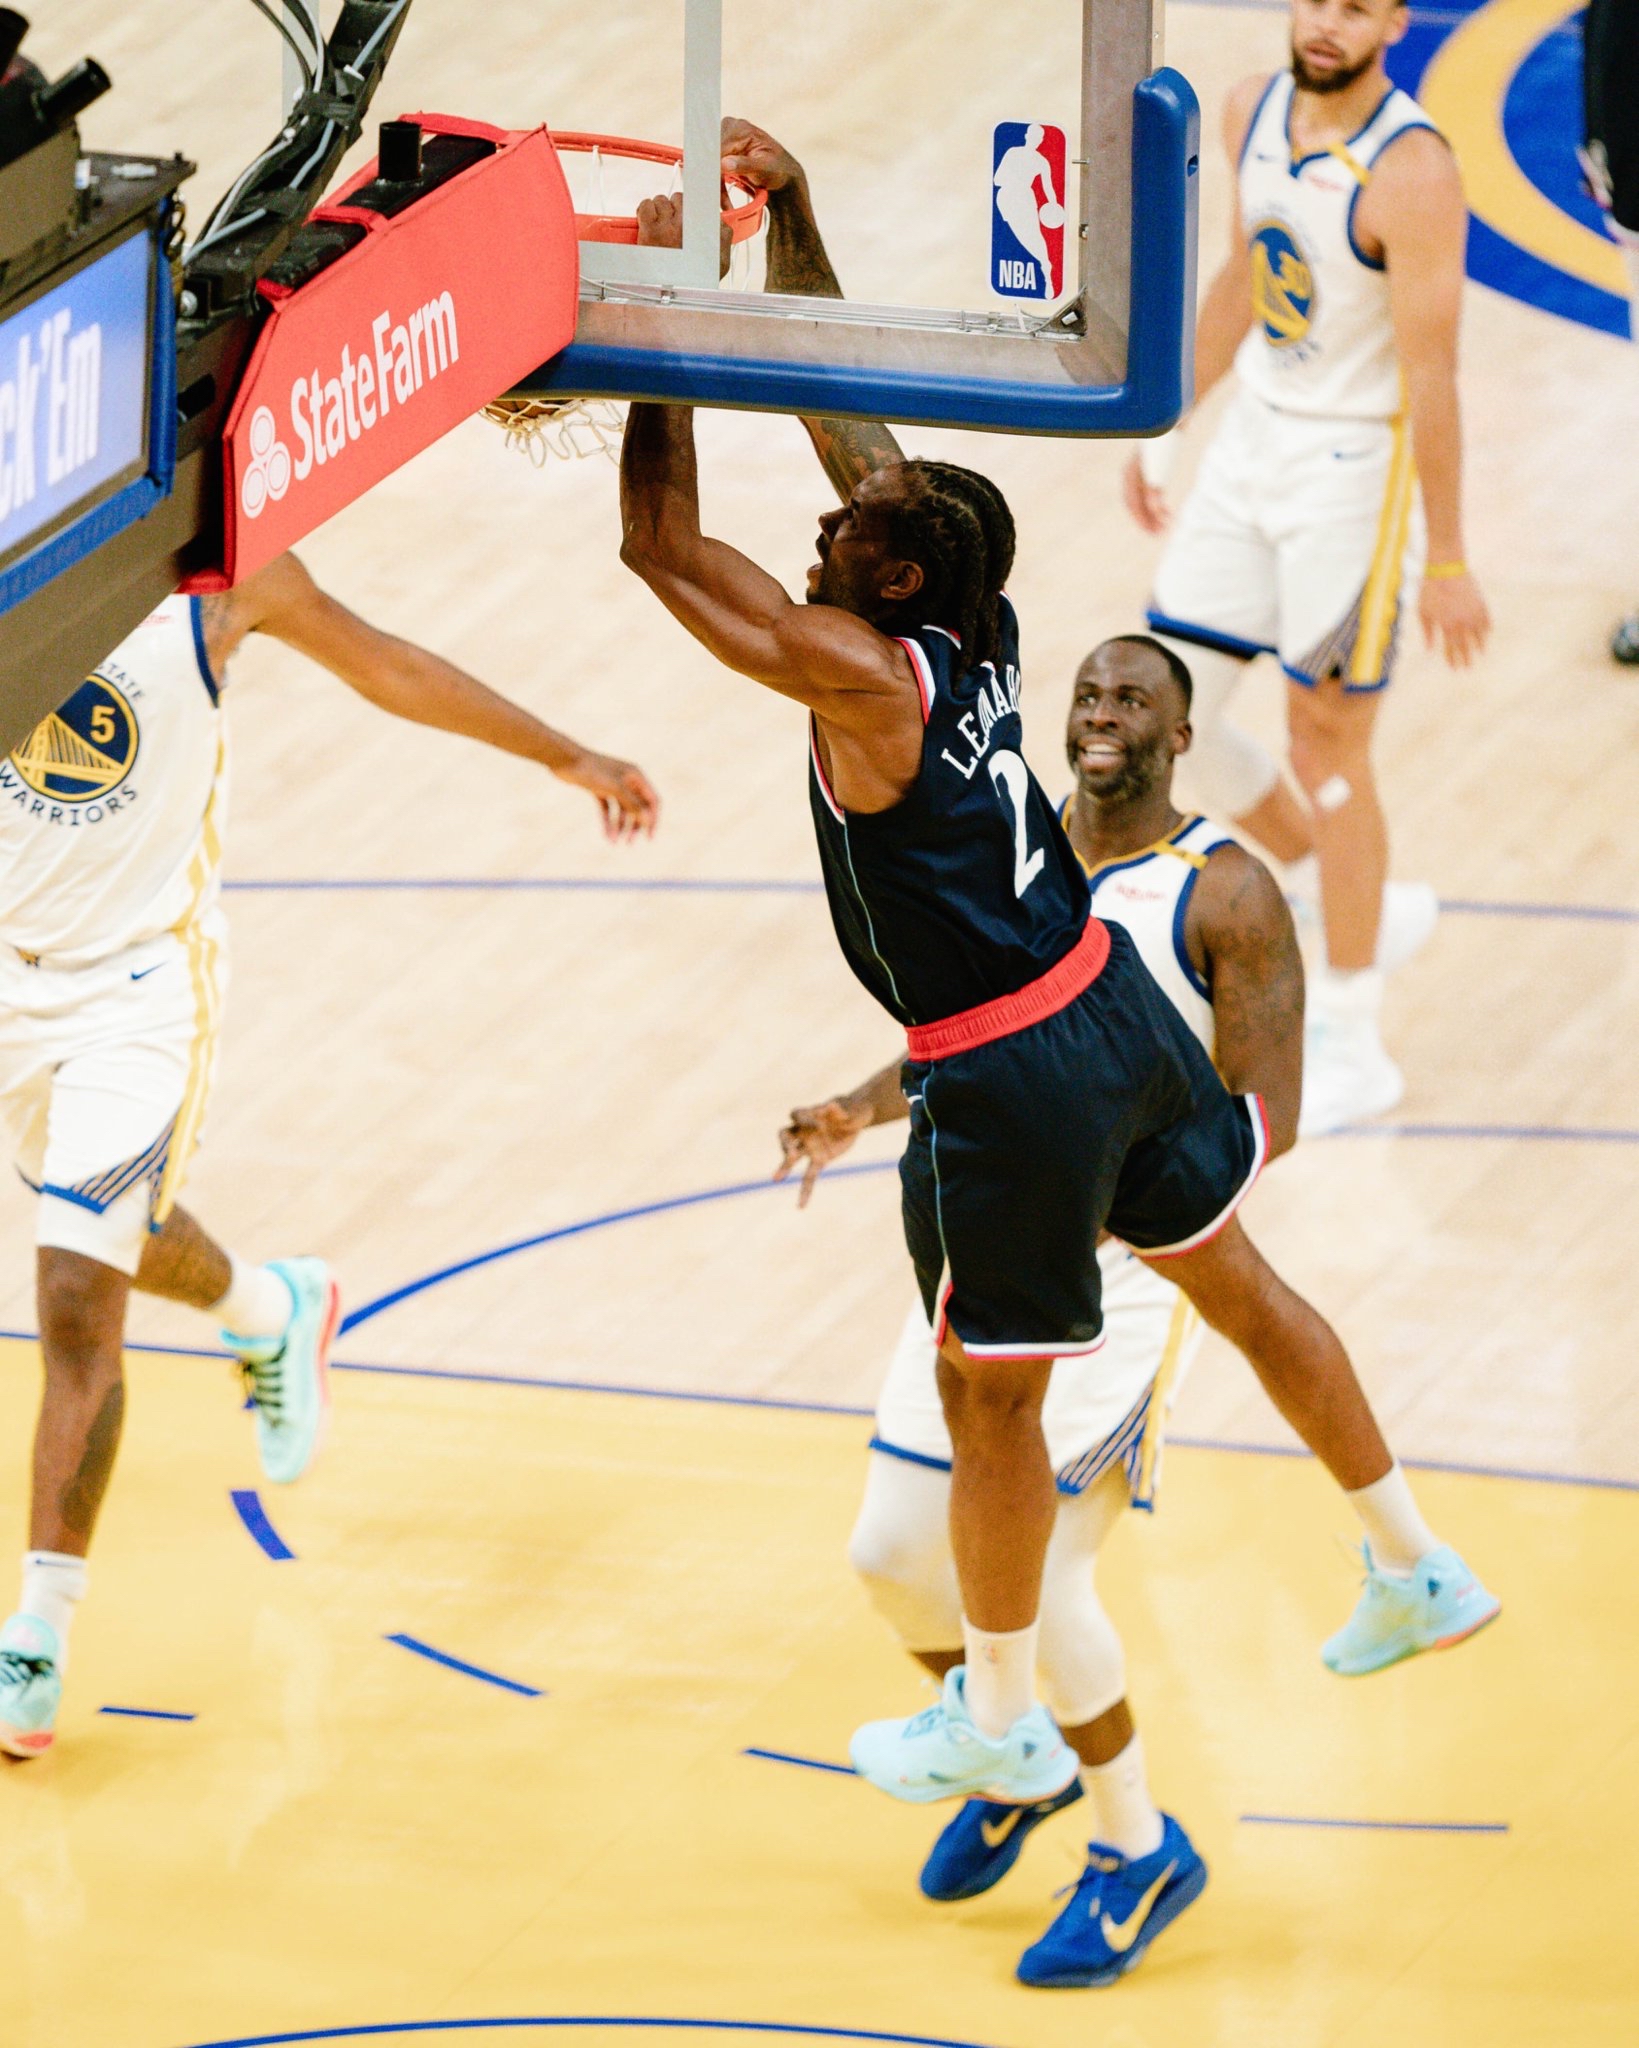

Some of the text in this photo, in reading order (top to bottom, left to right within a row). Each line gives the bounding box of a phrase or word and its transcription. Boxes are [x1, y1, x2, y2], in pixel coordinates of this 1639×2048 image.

[999, 259, 1037, 290] NBA
[90, 704, 116, 744] 5
[941, 664, 1021, 780] LEONAR
[0, 764, 138, 826] WARRIORS
[988, 749, 1045, 899] 2
